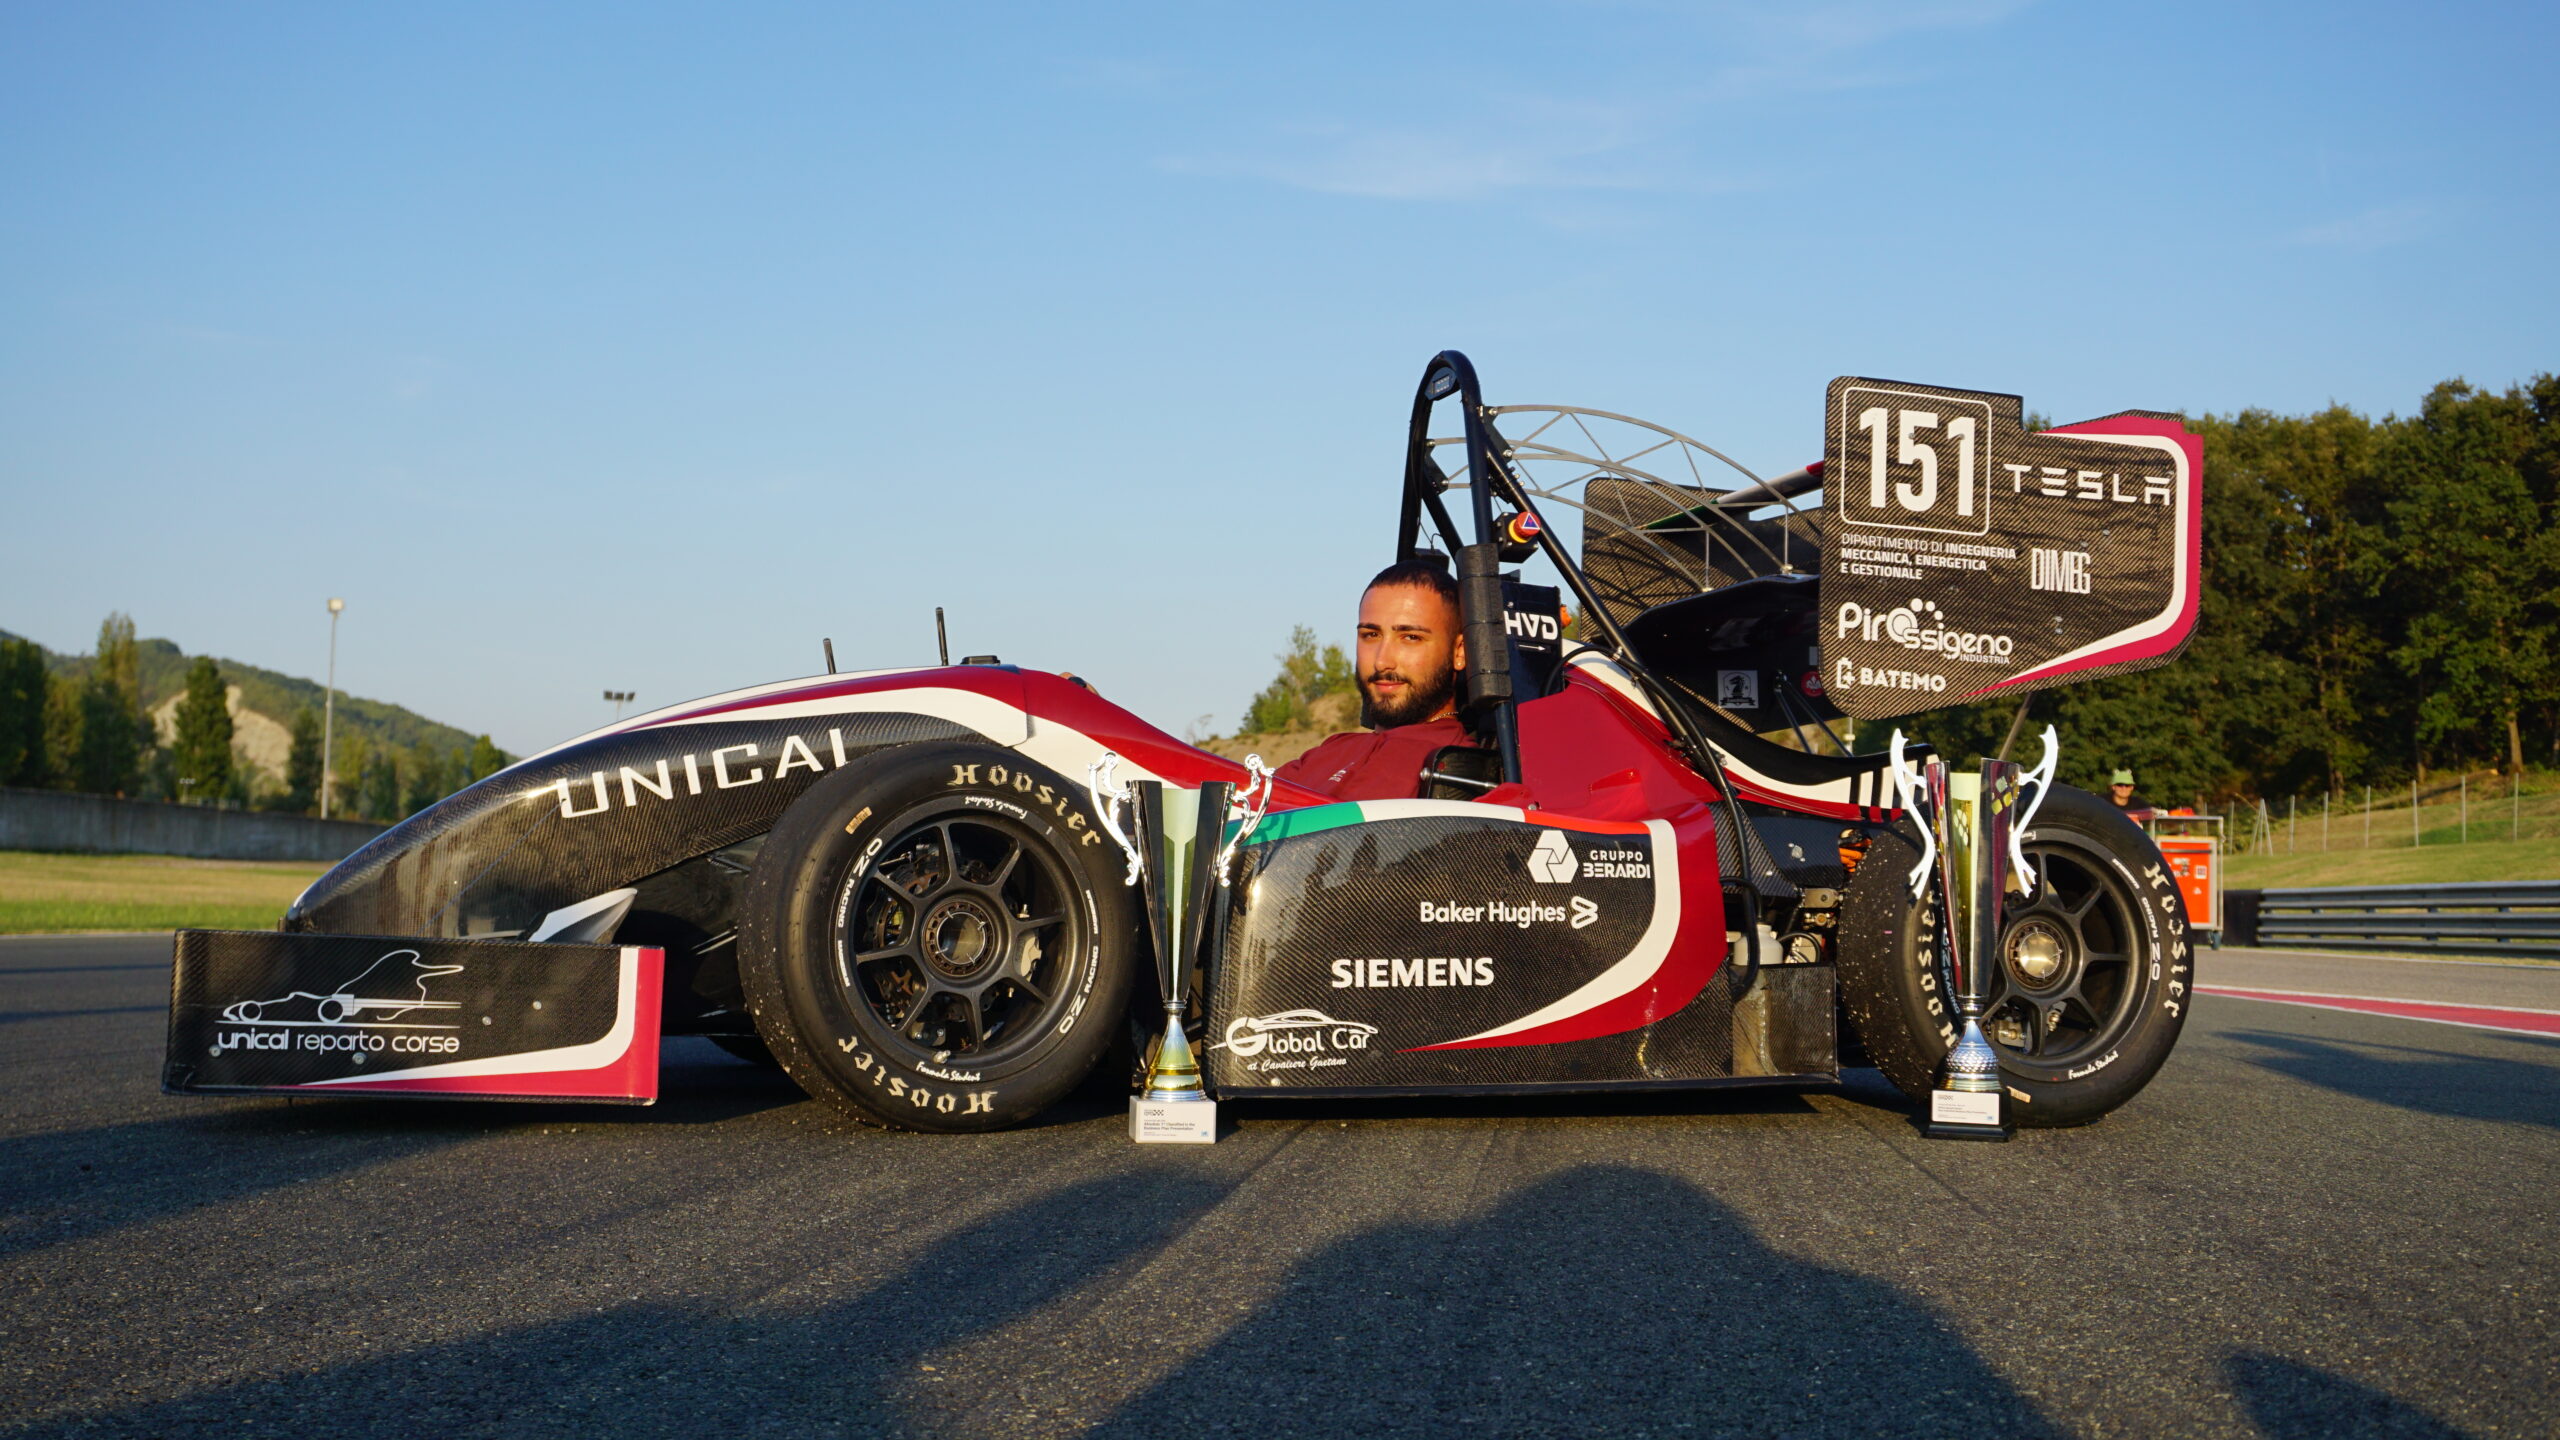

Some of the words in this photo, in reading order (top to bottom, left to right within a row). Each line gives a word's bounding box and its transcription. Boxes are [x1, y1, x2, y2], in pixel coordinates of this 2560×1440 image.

[1860, 407, 1975, 516] 151
[2004, 463, 2170, 505] TESLA
[1841, 533, 1928, 551] DIPARTIMENTO
[1931, 541, 1943, 552] DI
[1945, 542, 2017, 559] INGEGNERIA
[1841, 548, 1912, 566] MECCANICA,
[1915, 554, 1987, 571] ENERGETICA
[1840, 562, 1848, 573] E
[1851, 563, 1923, 580] GESTIONALE
[2031, 547, 2091, 594] DIMEG
[1503, 610, 1559, 640] HVD
[1960, 653, 2010, 665] INDUSTRIA
[1860, 667, 1947, 692] BATEMO
[947, 764, 1101, 846] Hoosier
[1583, 862, 1651, 879] BERARDI
[1590, 850, 1643, 862] GRUPPO
[837, 878, 855, 928] RACING
[1420, 901, 1485, 923] Baker
[1488, 900, 1566, 929] Hughes
[1084, 945, 1099, 994] RACING
[1331, 957, 1494, 989] SIEMENS
[217, 1027, 289, 1050] unical
[297, 1030, 385, 1055] reparto
[391, 1035, 460, 1053] corse
[1226, 1017, 1325, 1056] Global
[1332, 1028, 1370, 1049] Car
[1261, 1058, 1306, 1072] Cavaliere
[1309, 1056, 1347, 1070] Gaetano
